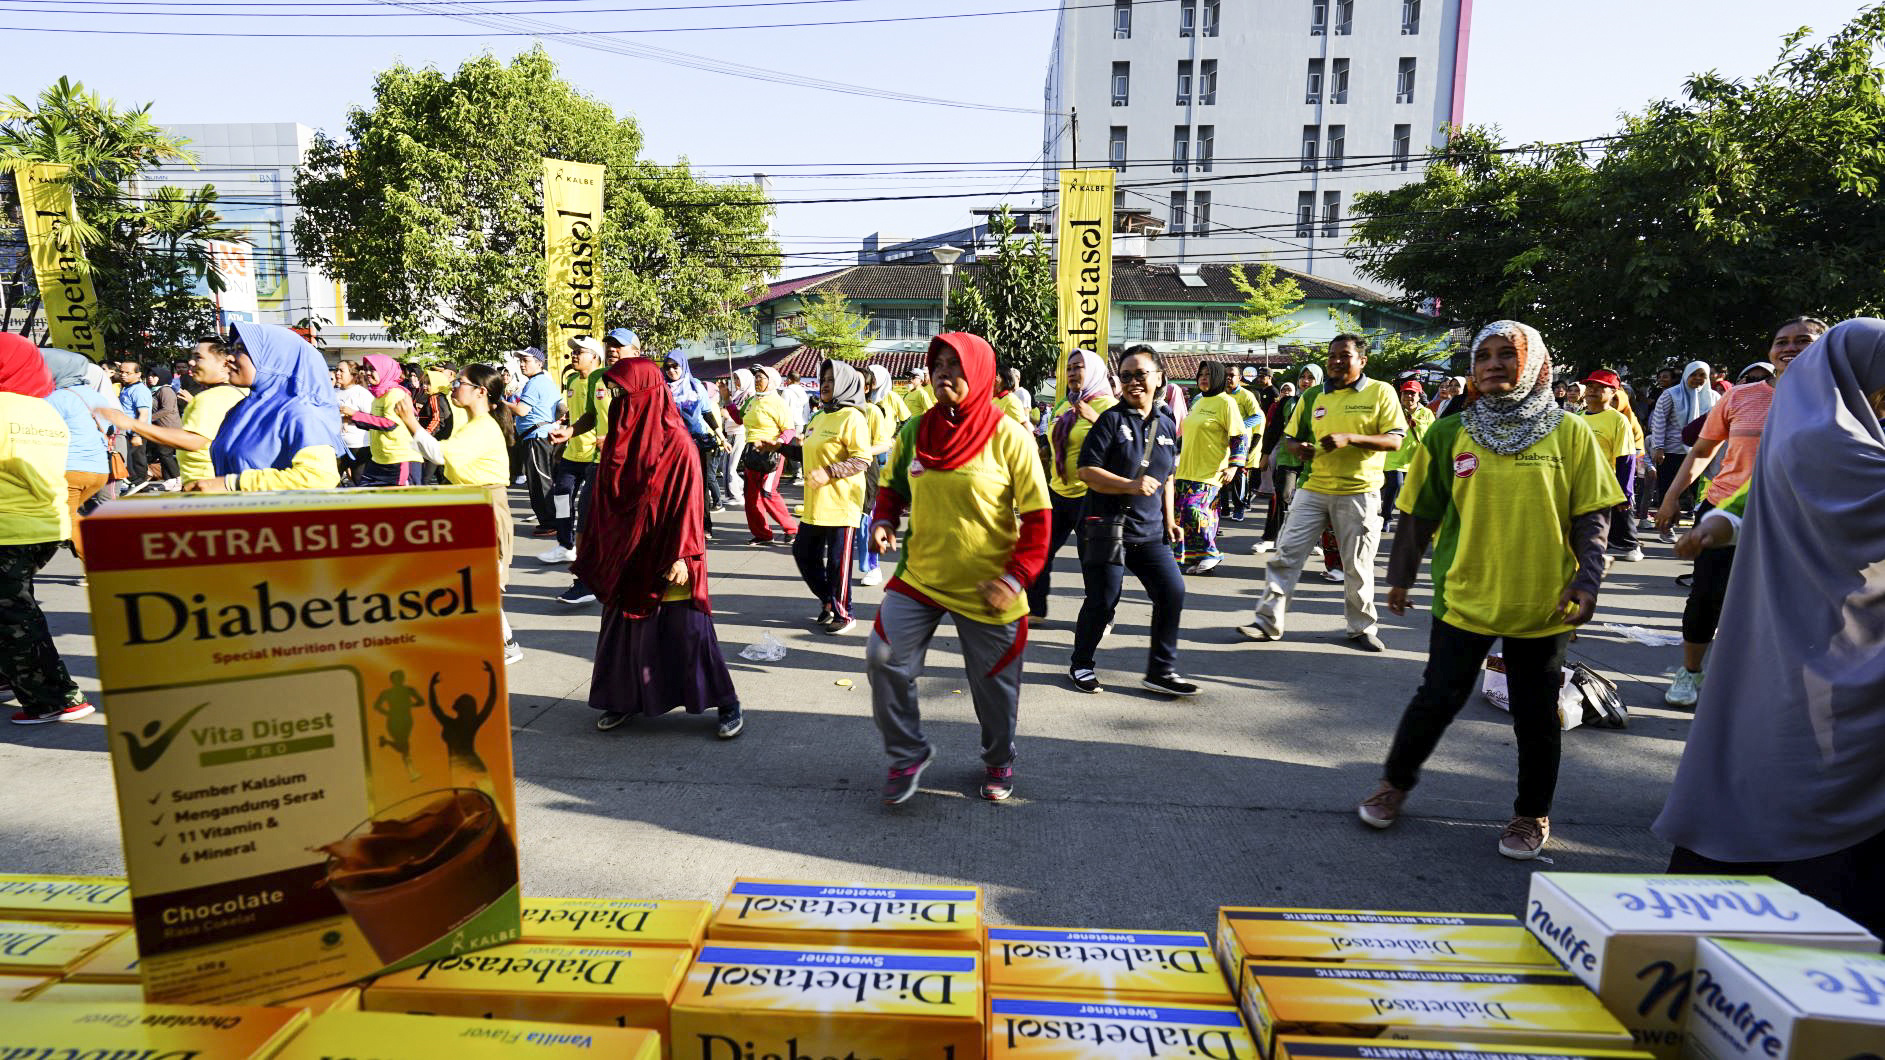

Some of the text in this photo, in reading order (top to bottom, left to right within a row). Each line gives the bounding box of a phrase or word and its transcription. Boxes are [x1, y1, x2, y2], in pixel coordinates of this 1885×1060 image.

[259, 174, 277, 183] BNI
[566, 176, 595, 186] KALBE
[1080, 184, 1105, 192] KALBE
[227, 312, 244, 322] ATM
[349, 332, 367, 343] Ray
[141, 518, 453, 560] EXTRA ISI 30 GR
[114, 566, 478, 647] Diabetasol
[212, 633, 417, 665] Special Nutrition for Diabetic
[190, 712, 334, 746] Vita Digest
[246, 743, 287, 760] PRO
[171, 773, 307, 804] Sumber Kalsium
[175, 789, 325, 824] Mengandung Serat
[178, 816, 280, 844] 11 Vitamin &
[179, 841, 257, 865] 6 Mineral
[819, 886, 897, 899] Sweetener
[162, 888, 285, 925] Chocolate
[608, 900, 659, 909] Vanilla
[737, 895, 960, 924] Diabetasol
[163, 912, 257, 939] Rasa Cokelat
[523, 908, 653, 932] Diabeta
[1282, 912, 1465, 925] SPECIAL NUTRITION FOR DIABETIC
[470, 927, 517, 949] KALBE
[1066, 933, 1136, 943] Sweetener
[1329, 936, 1458, 955] Diabetasol
[579, 948, 633, 959] Vanilla
[797, 951, 885, 967] Sweetener
[1001, 942, 1209, 975] Diabetasol
[416, 953, 626, 984] Diabetasol
[1315, 968, 1517, 983] SPECIAL NUTRITION FOR DIABETIC
[701, 965, 956, 1006] Diabetasol
[1079, 1004, 1159, 1020] Sweetener
[1367, 997, 1512, 1021] Diabetasol
[140, 1014, 242, 1030] Chocolate
[458, 1026, 593, 1049] Vanilla Flavor
[1004, 1017, 1241, 1060] Diabetasol
[1358, 1046, 1422, 1059] DIABETIC
[1423, 1049, 1451, 1060] FOR
